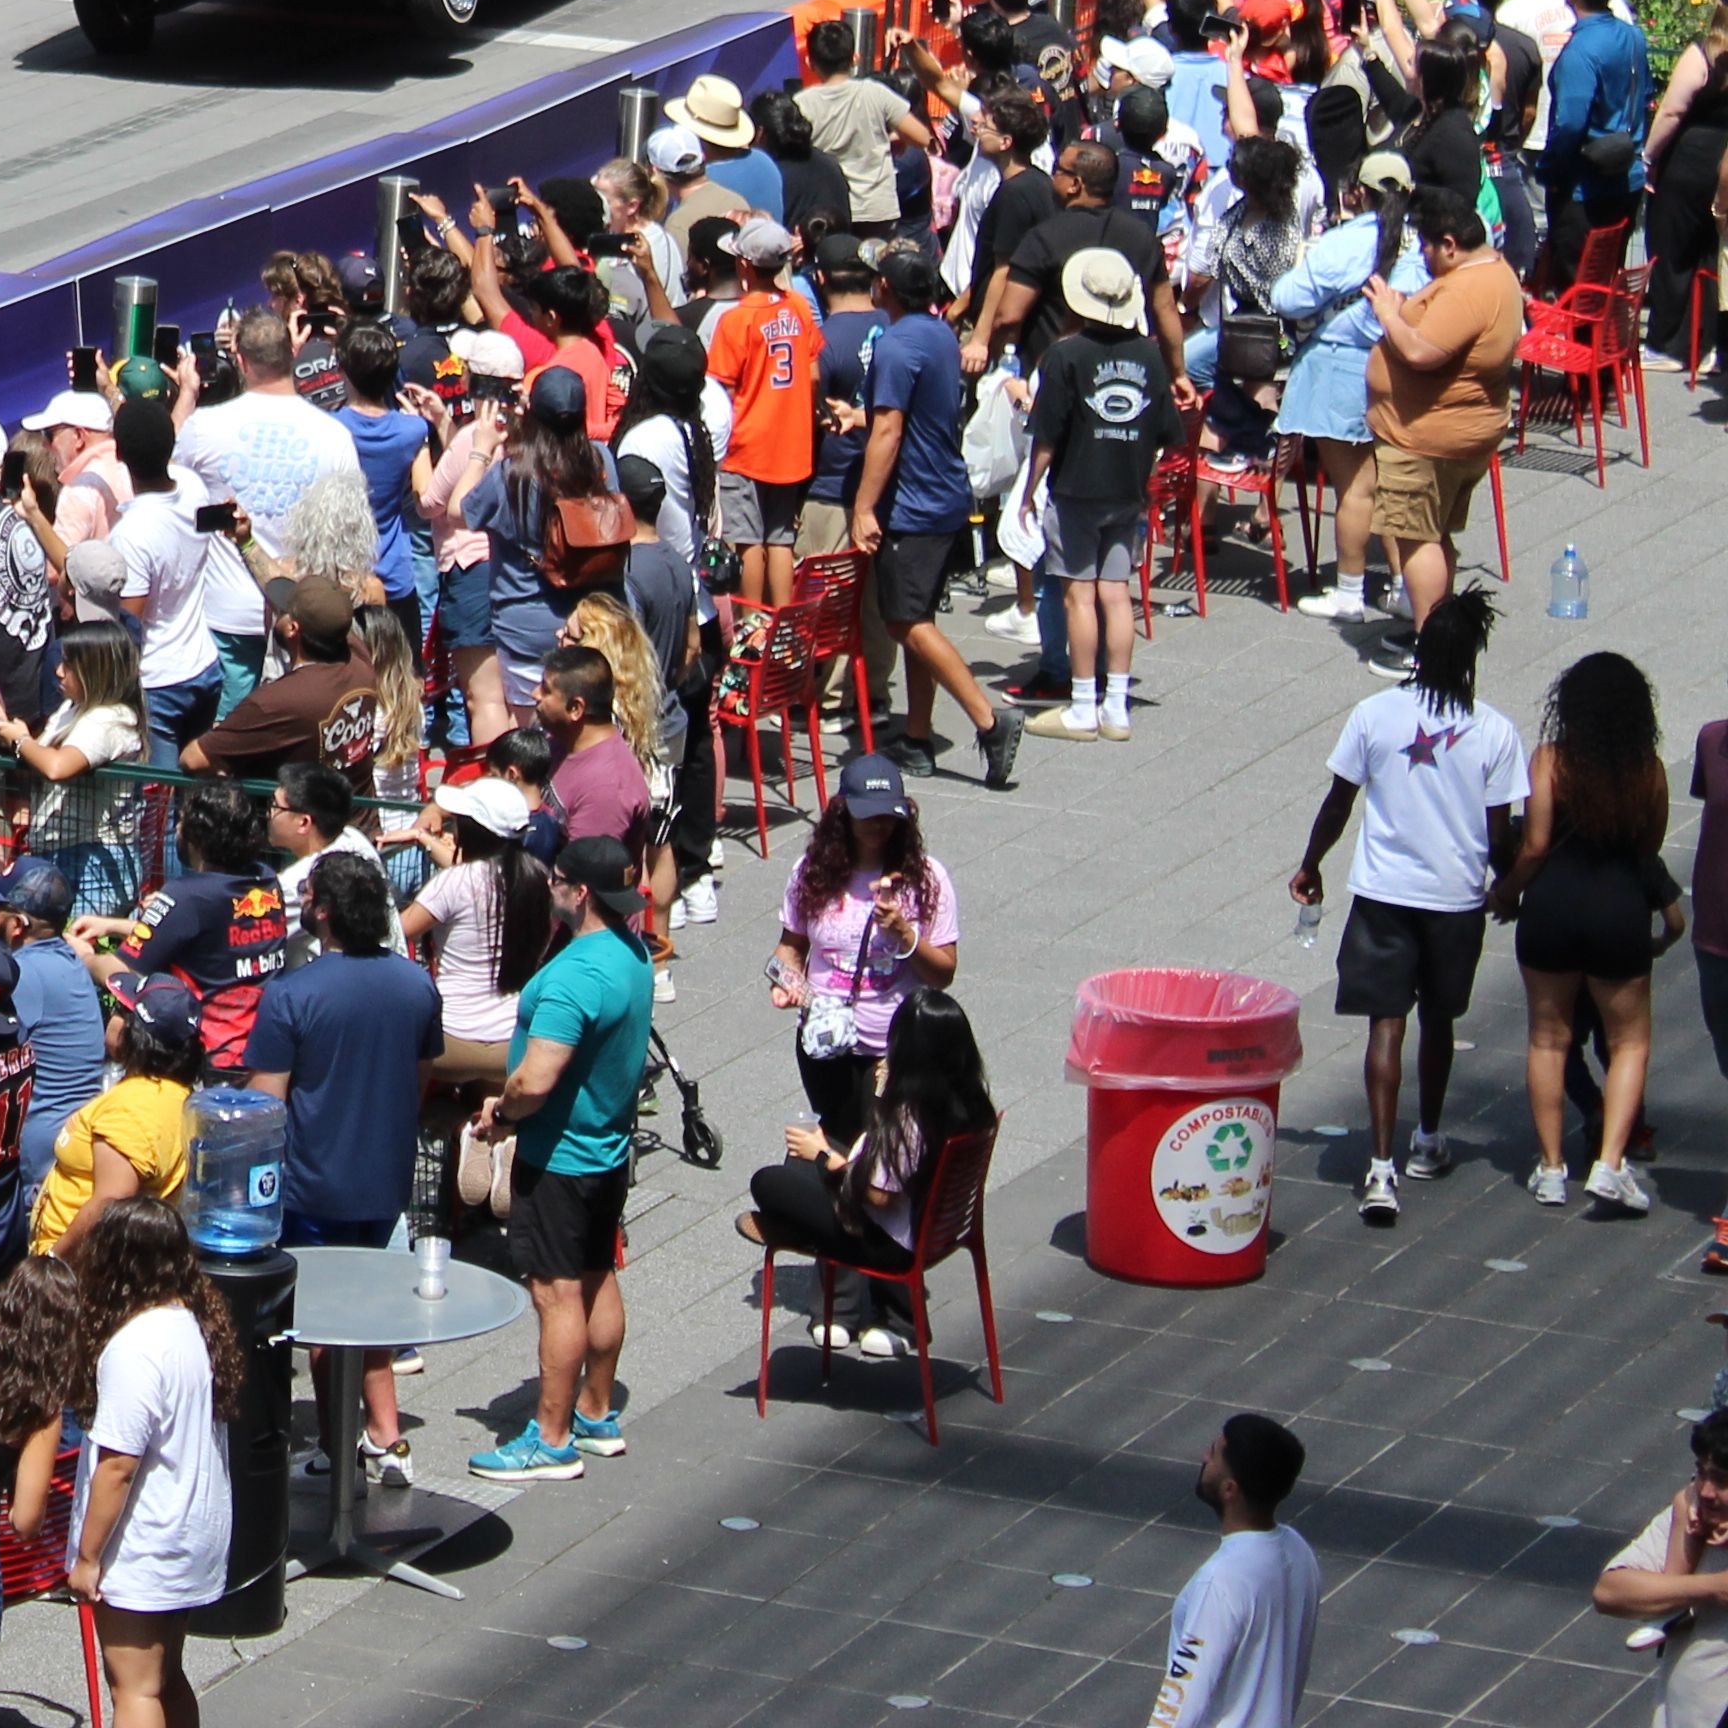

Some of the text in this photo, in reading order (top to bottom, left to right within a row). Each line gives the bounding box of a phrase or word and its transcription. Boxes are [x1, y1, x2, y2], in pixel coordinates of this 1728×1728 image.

[761, 309, 802, 344] PEÑA
[769, 340, 793, 390] 3
[236, 953, 276, 978] Mobil
